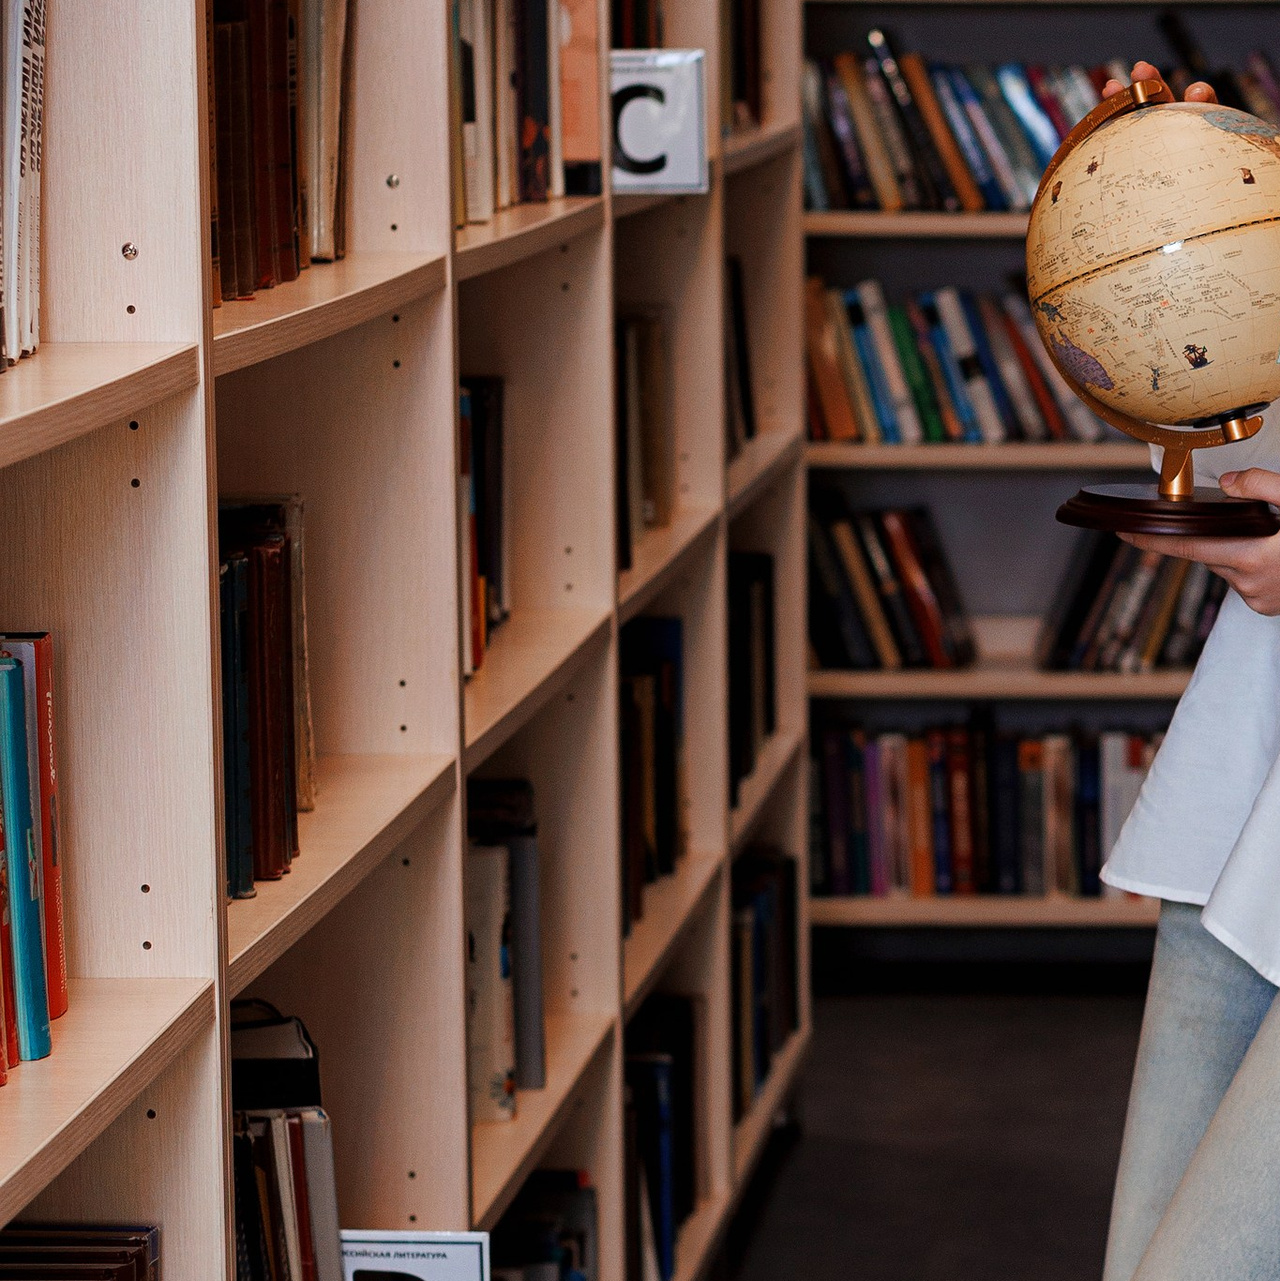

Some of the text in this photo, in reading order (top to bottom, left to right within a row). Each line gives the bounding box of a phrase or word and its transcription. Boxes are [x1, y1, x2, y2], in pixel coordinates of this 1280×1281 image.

[19, 56, 31, 178] ПОЛЯКОВ
[612, 83, 668, 175] С
[393, 1251, 447, 1261] ЛИТЕРАТУРА
